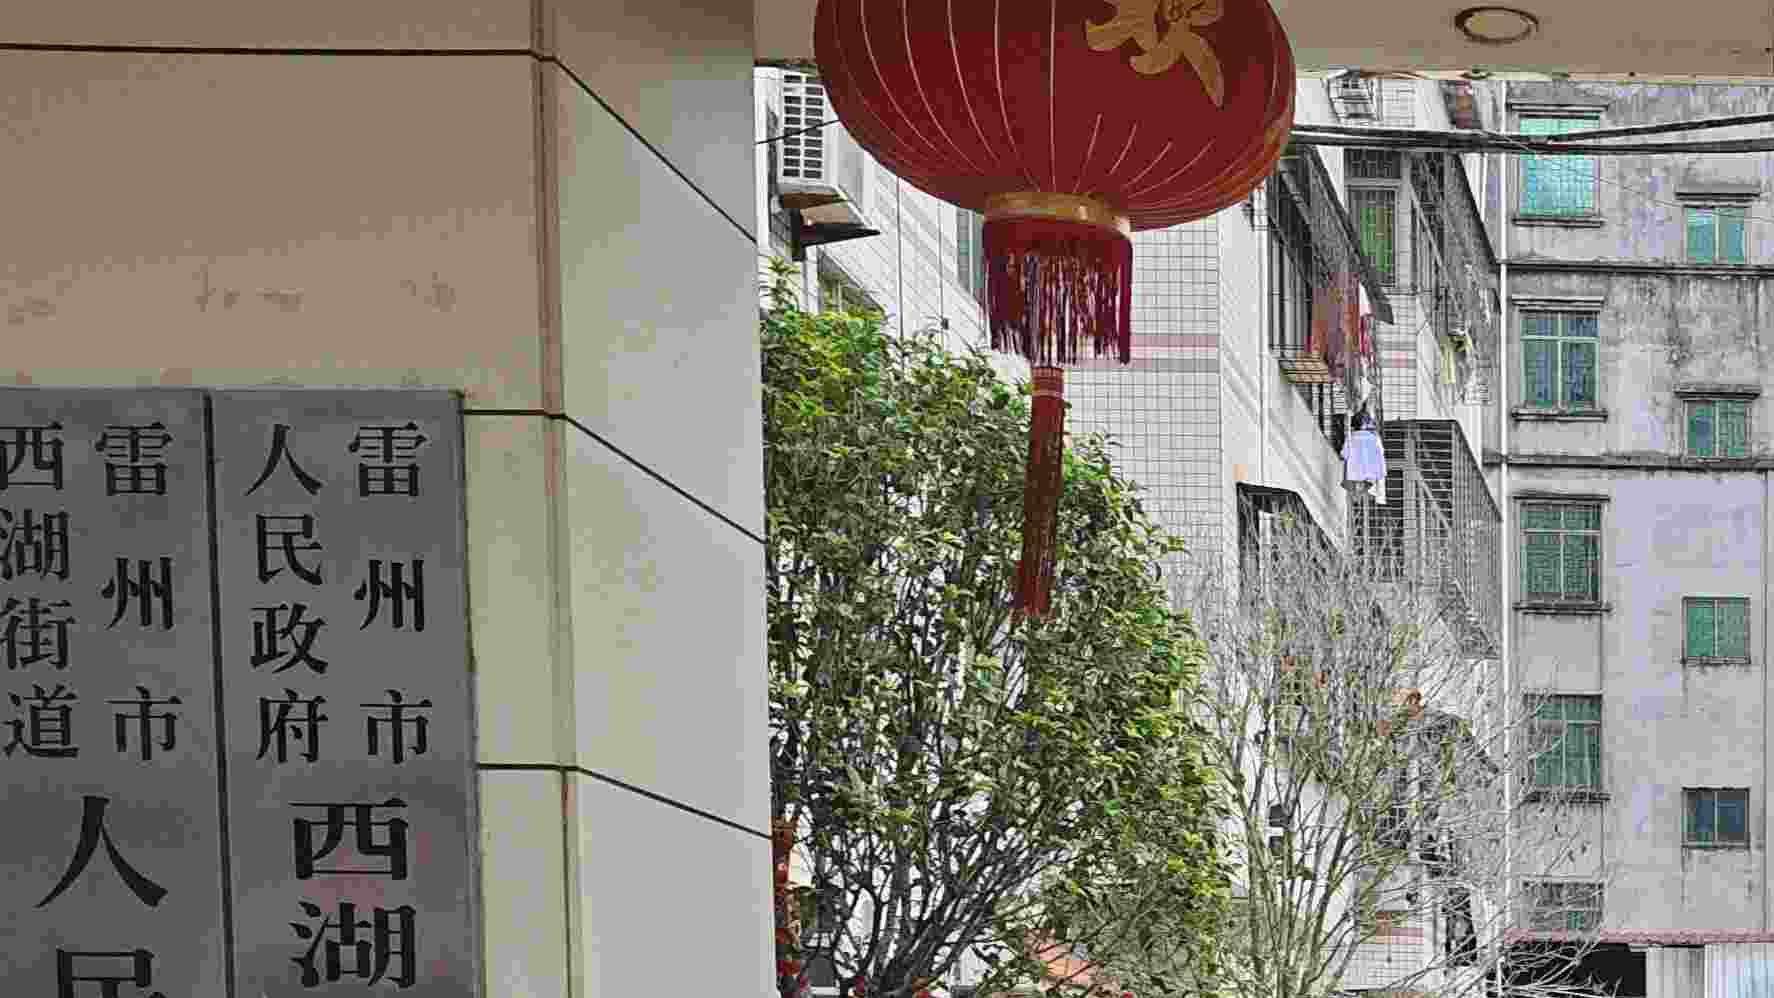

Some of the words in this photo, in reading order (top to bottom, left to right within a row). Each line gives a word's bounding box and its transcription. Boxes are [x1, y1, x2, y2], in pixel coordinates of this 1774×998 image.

[0, 421, 81, 760] 西湖街道
[95, 421, 182, 761] 雷州市
[245, 422, 329, 764] 人民政府
[347, 422, 434, 765] 雷州市
